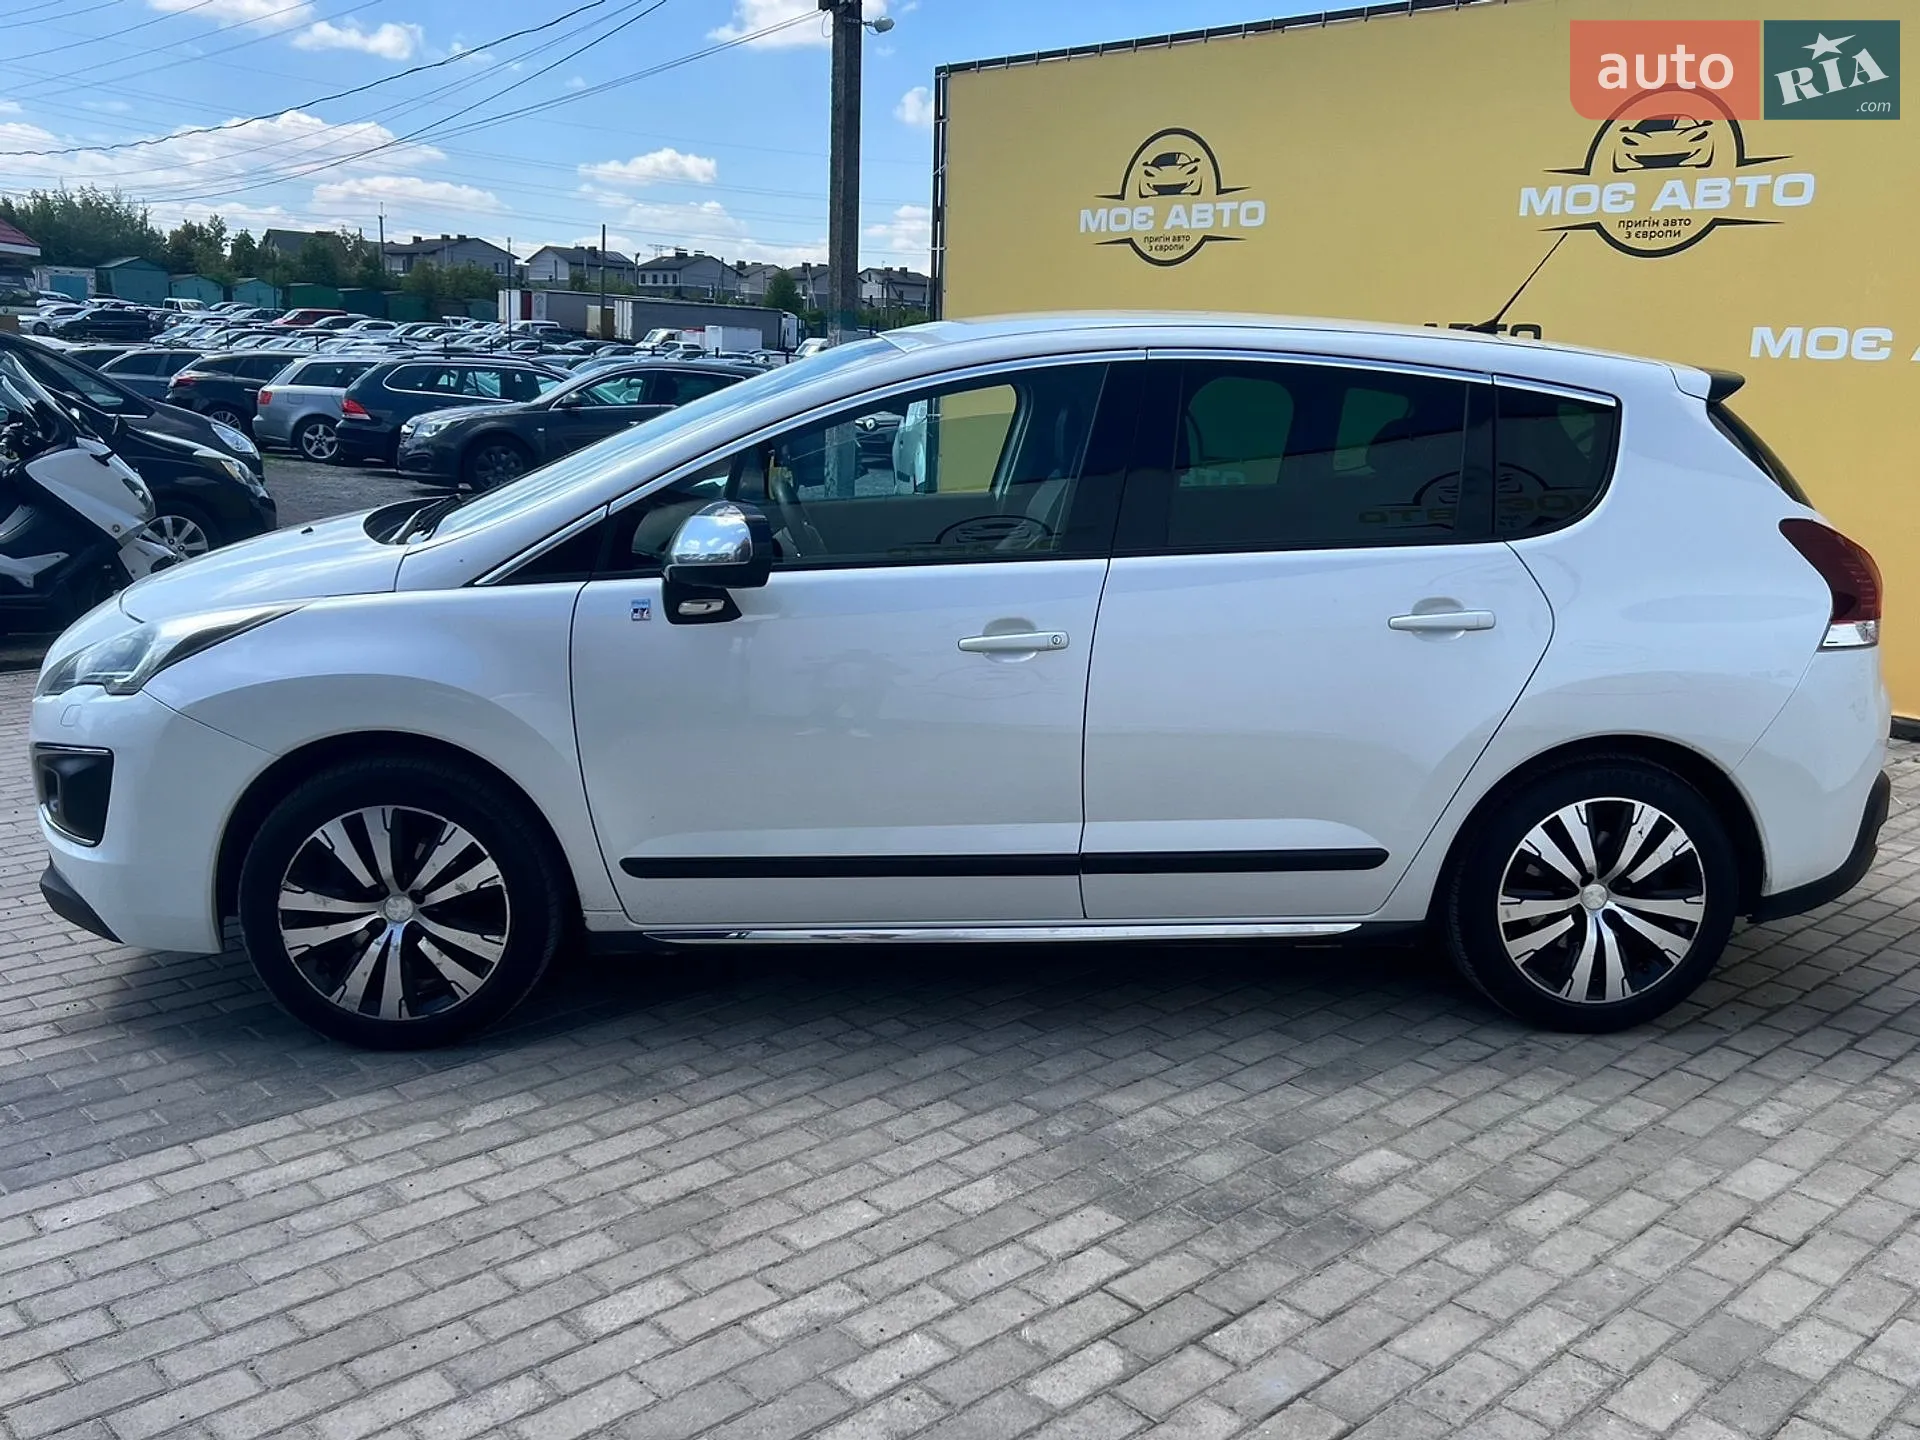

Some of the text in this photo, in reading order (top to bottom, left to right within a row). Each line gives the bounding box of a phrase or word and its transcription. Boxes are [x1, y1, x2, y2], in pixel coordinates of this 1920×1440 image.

[1518, 173, 1815, 217] МОЄ АВТО
[1079, 200, 1266, 233] МОЄ АВТО
[1617, 216, 1692, 230] пригін авто
[1172, 234, 1191, 242] авто
[1624, 229, 1682, 240] з європи
[1749, 326, 1894, 361] МОЄ
